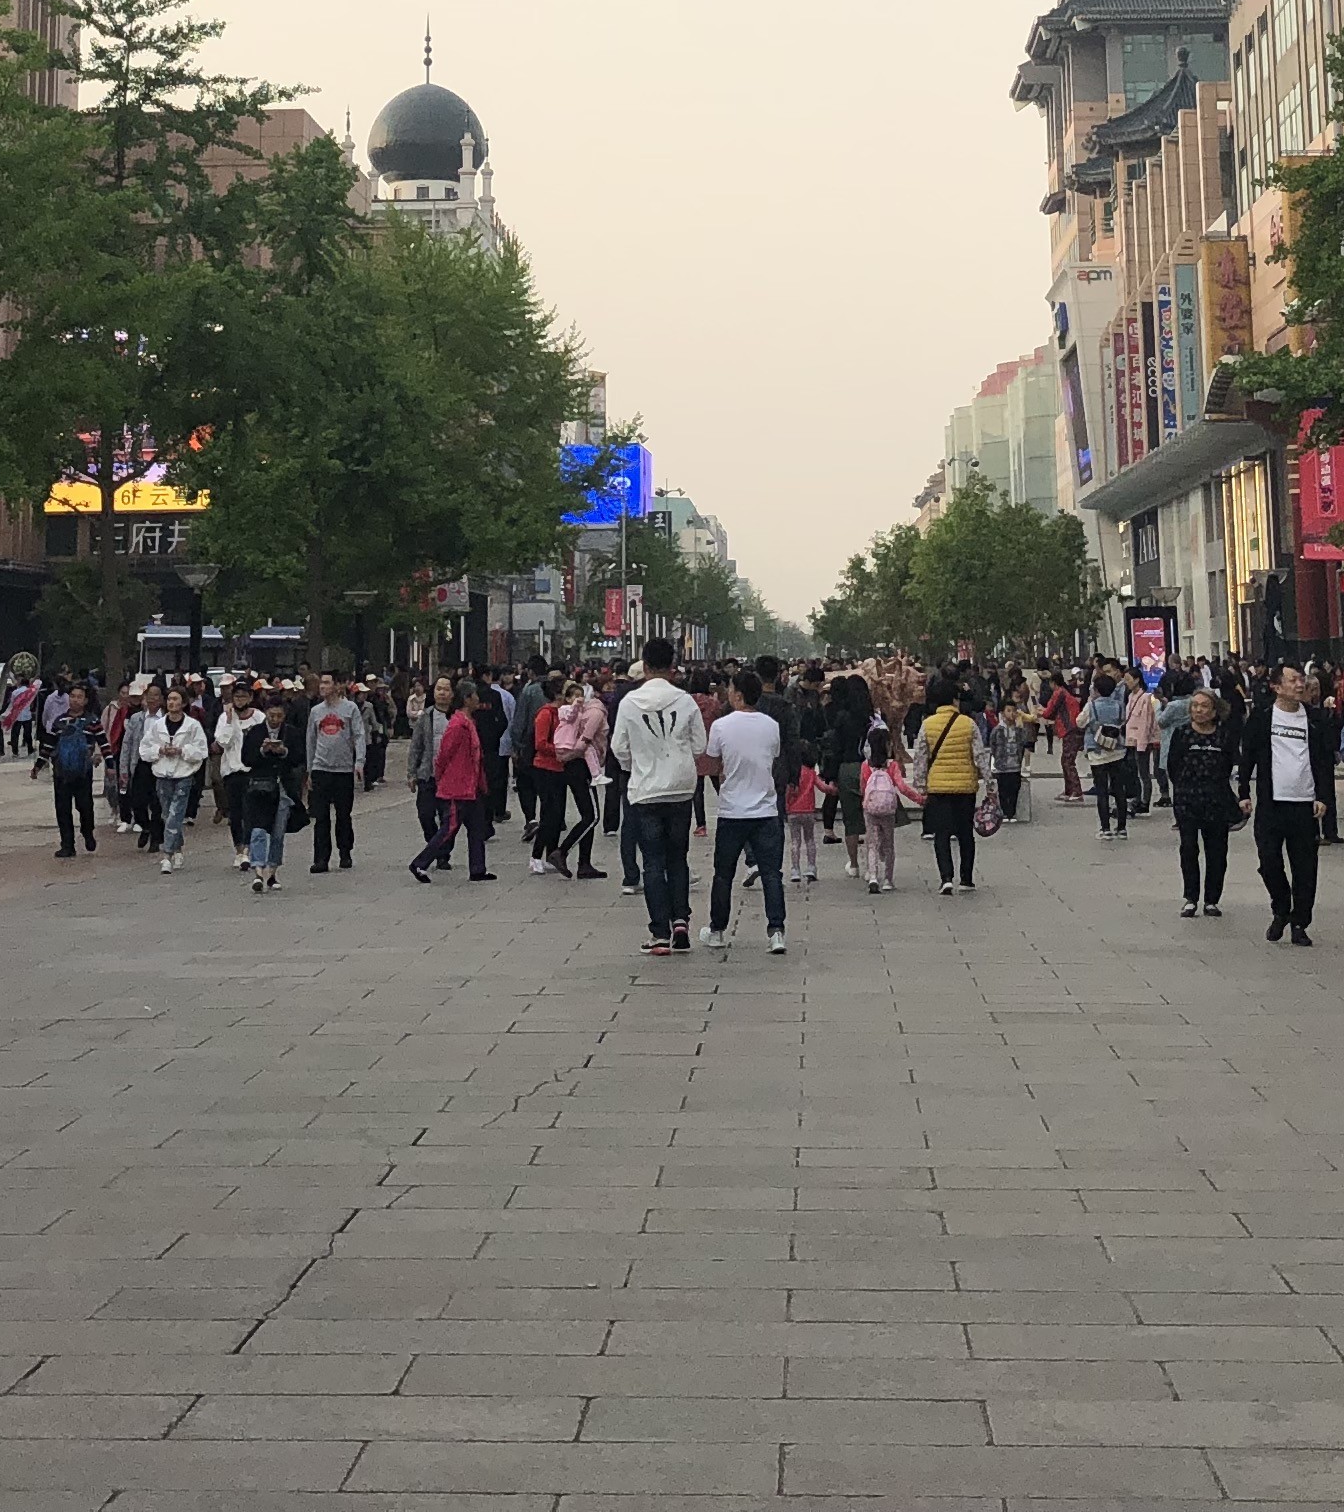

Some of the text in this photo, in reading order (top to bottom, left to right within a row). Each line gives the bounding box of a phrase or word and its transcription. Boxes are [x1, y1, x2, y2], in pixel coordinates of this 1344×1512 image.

[1077, 269, 1112, 284] apm
[1180, 292, 1195, 335] 外婆家
[1147, 356, 1159, 398] ecco
